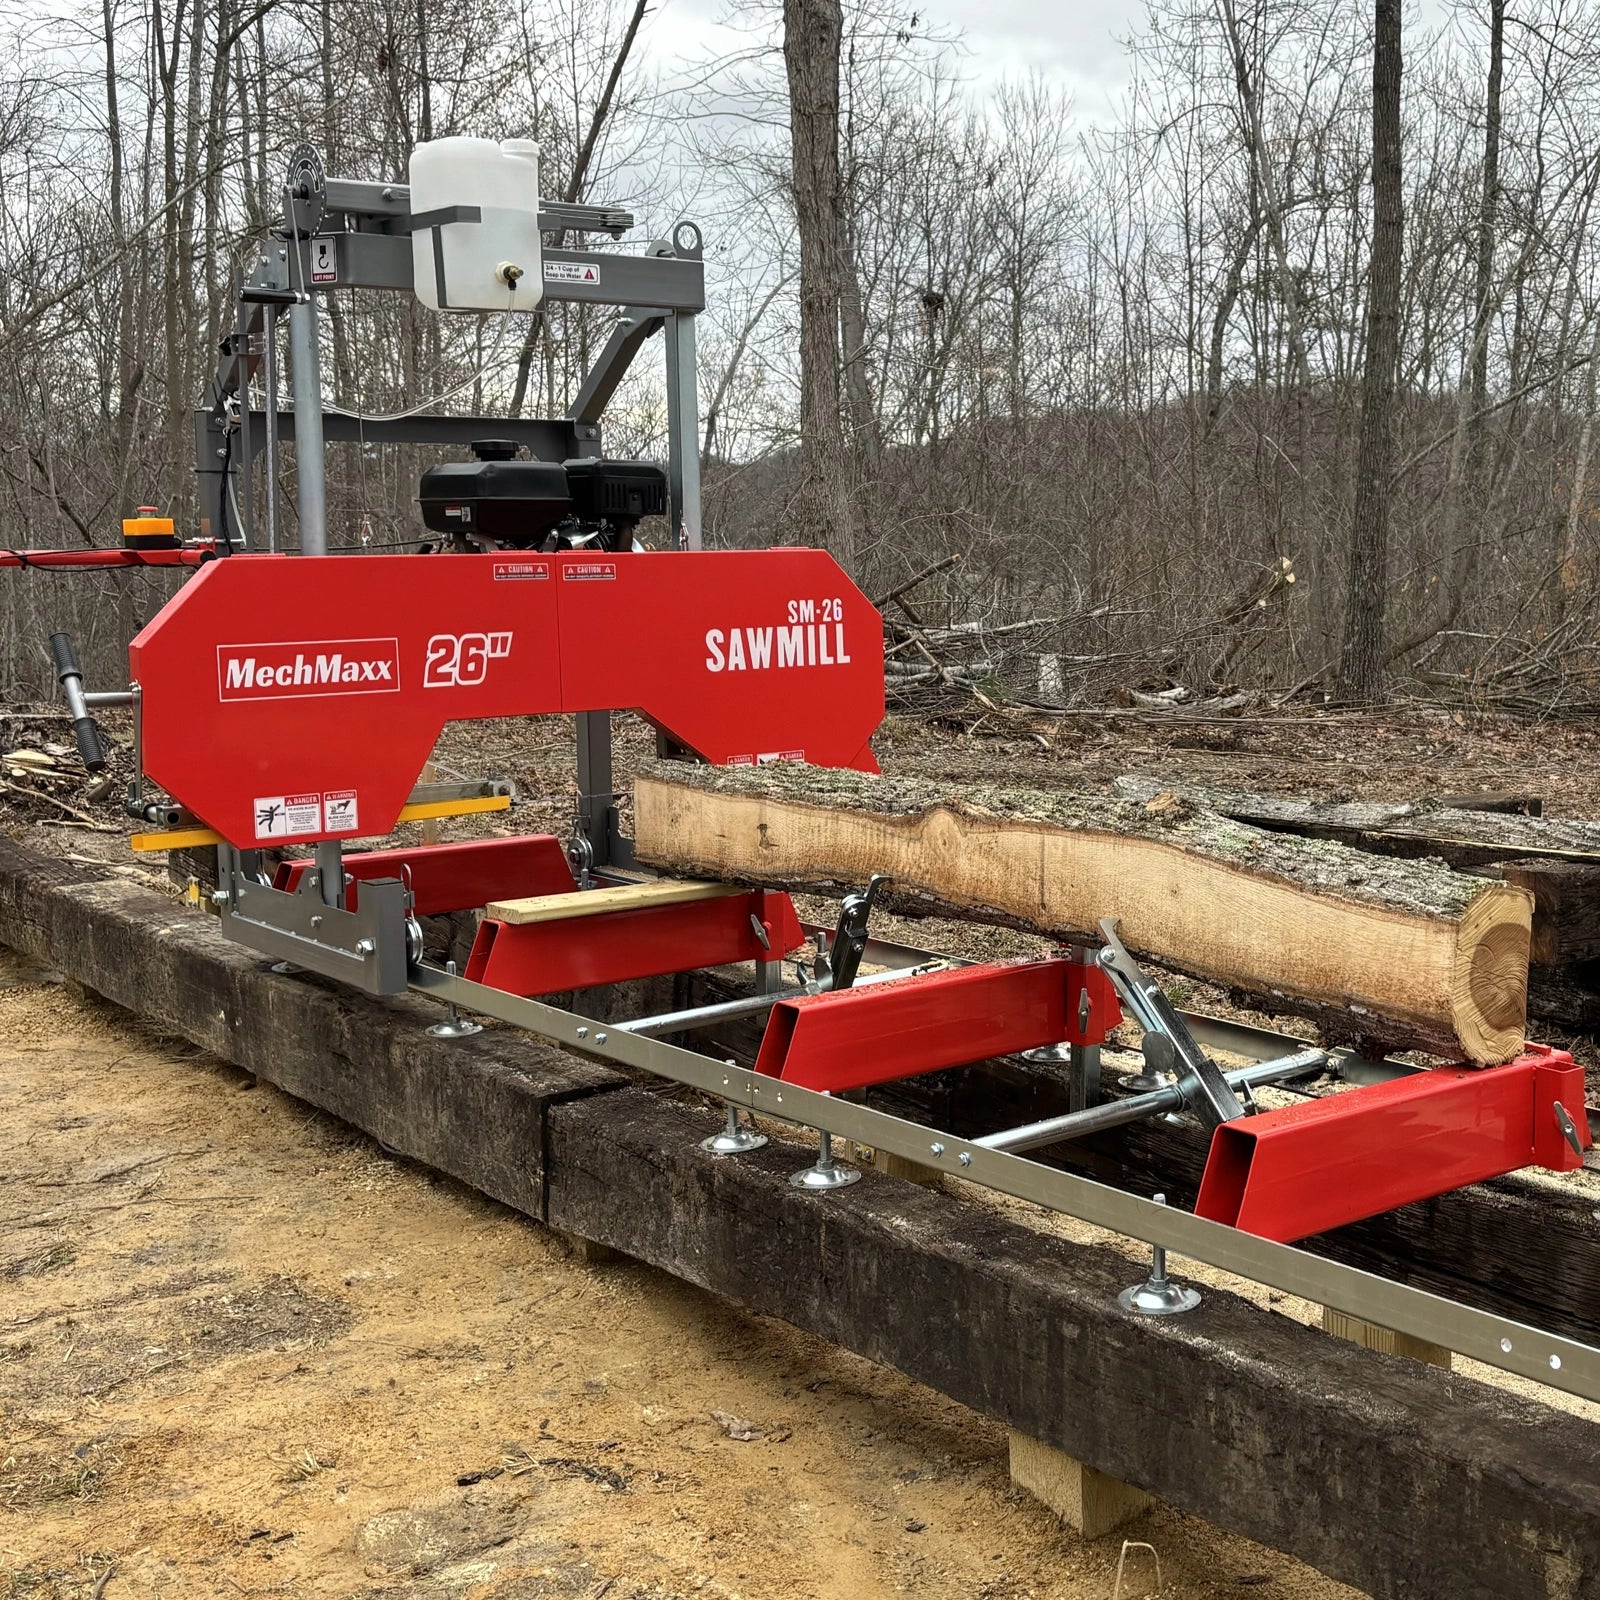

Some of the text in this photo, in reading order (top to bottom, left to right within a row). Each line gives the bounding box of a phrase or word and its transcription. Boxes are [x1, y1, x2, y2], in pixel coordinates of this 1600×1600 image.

[508, 565, 533, 573] CAUTION
[577, 566, 601, 574] CAUTION
[787, 598, 843, 624] SM-26
[705, 623, 851, 672] SAWMILL
[225, 654, 393, 689] MechMaxx
[332, 791, 355, 799] WARNING
[293, 796, 318, 804] DANGER
